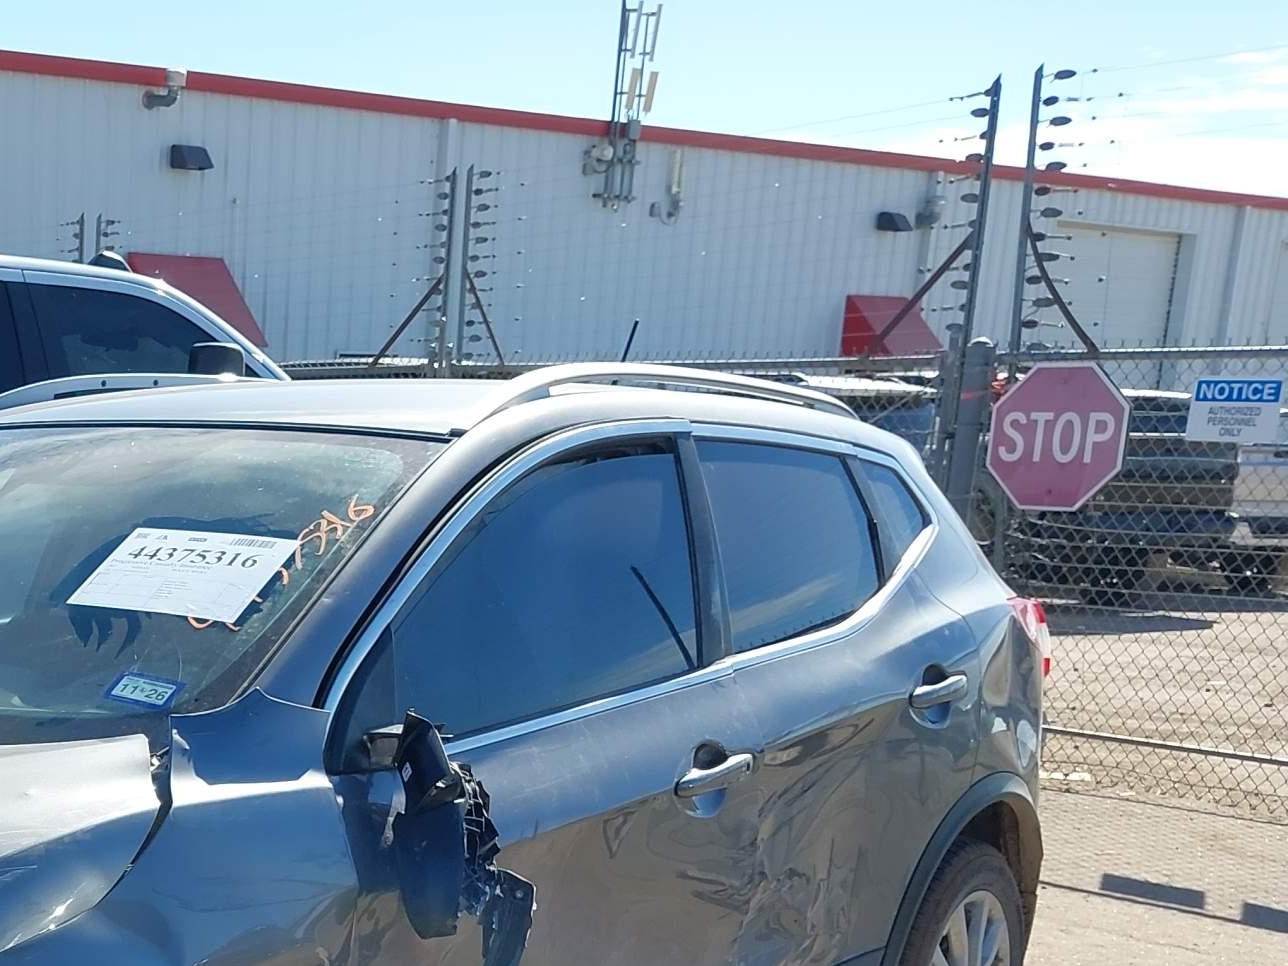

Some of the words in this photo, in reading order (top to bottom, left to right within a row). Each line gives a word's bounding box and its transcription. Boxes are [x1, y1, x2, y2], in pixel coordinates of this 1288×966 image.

[1199, 383, 1278, 400] NOTICE
[1208, 407, 1262, 417] AUTHORIZED
[1207, 417, 1258, 428] PERSONNEL
[998, 411, 1115, 464] STOP
[1218, 427, 1242, 438] ONLY
[128, 546, 262, 568] 44375316
